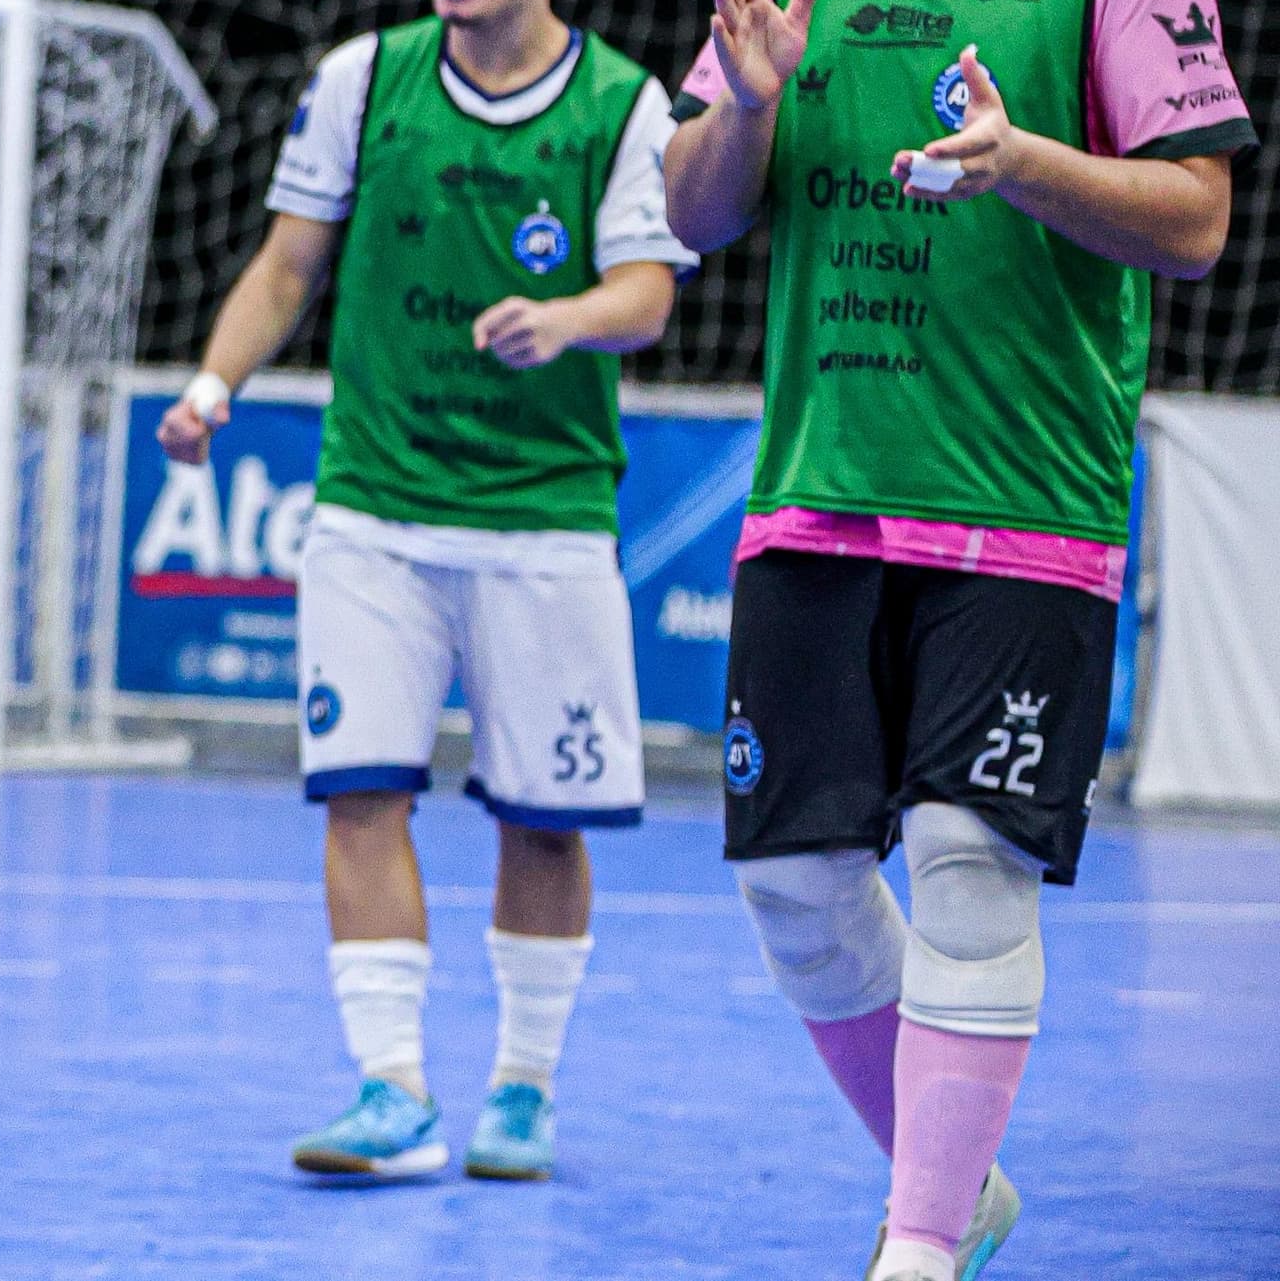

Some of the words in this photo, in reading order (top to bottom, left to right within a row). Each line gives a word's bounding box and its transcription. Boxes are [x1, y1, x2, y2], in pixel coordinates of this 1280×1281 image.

[830, 236, 932, 274] unisul
[553, 733, 605, 783] 55
[968, 727, 1045, 798] 22
